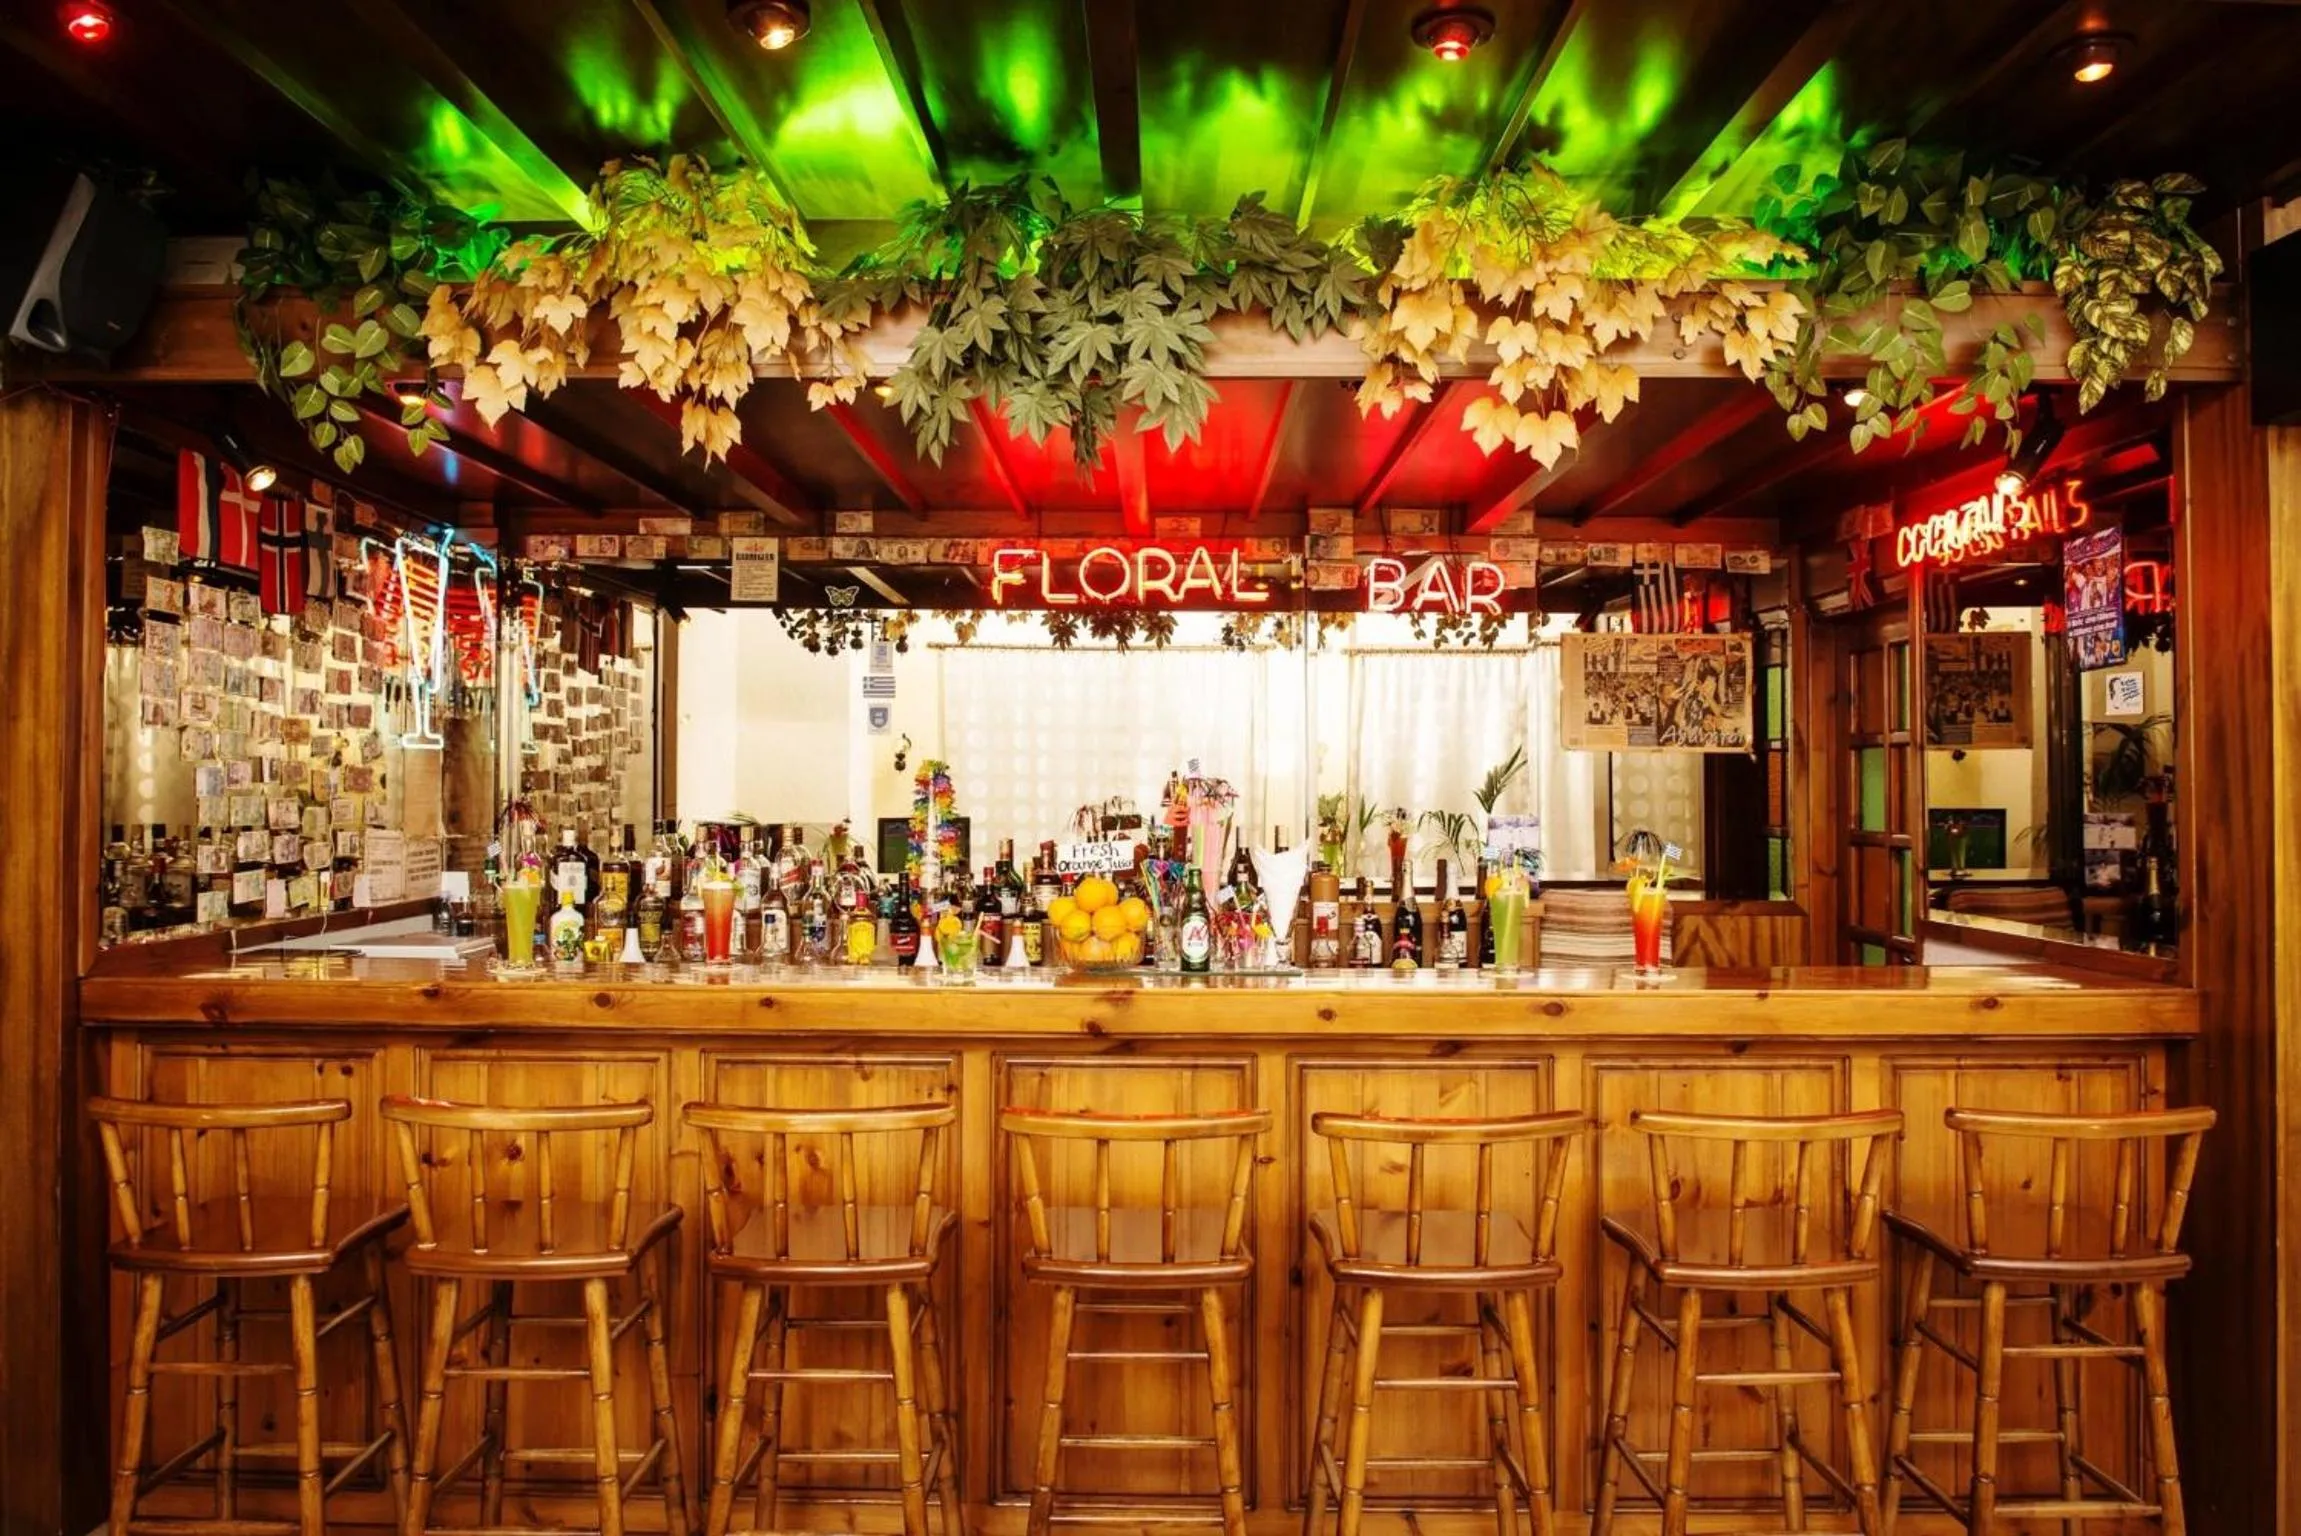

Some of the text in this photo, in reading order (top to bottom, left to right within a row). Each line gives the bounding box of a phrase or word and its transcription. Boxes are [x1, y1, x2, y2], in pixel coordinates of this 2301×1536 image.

[992, 546, 1505, 615] FLORAL BAR
[1072, 842, 1120, 859] Fresh
